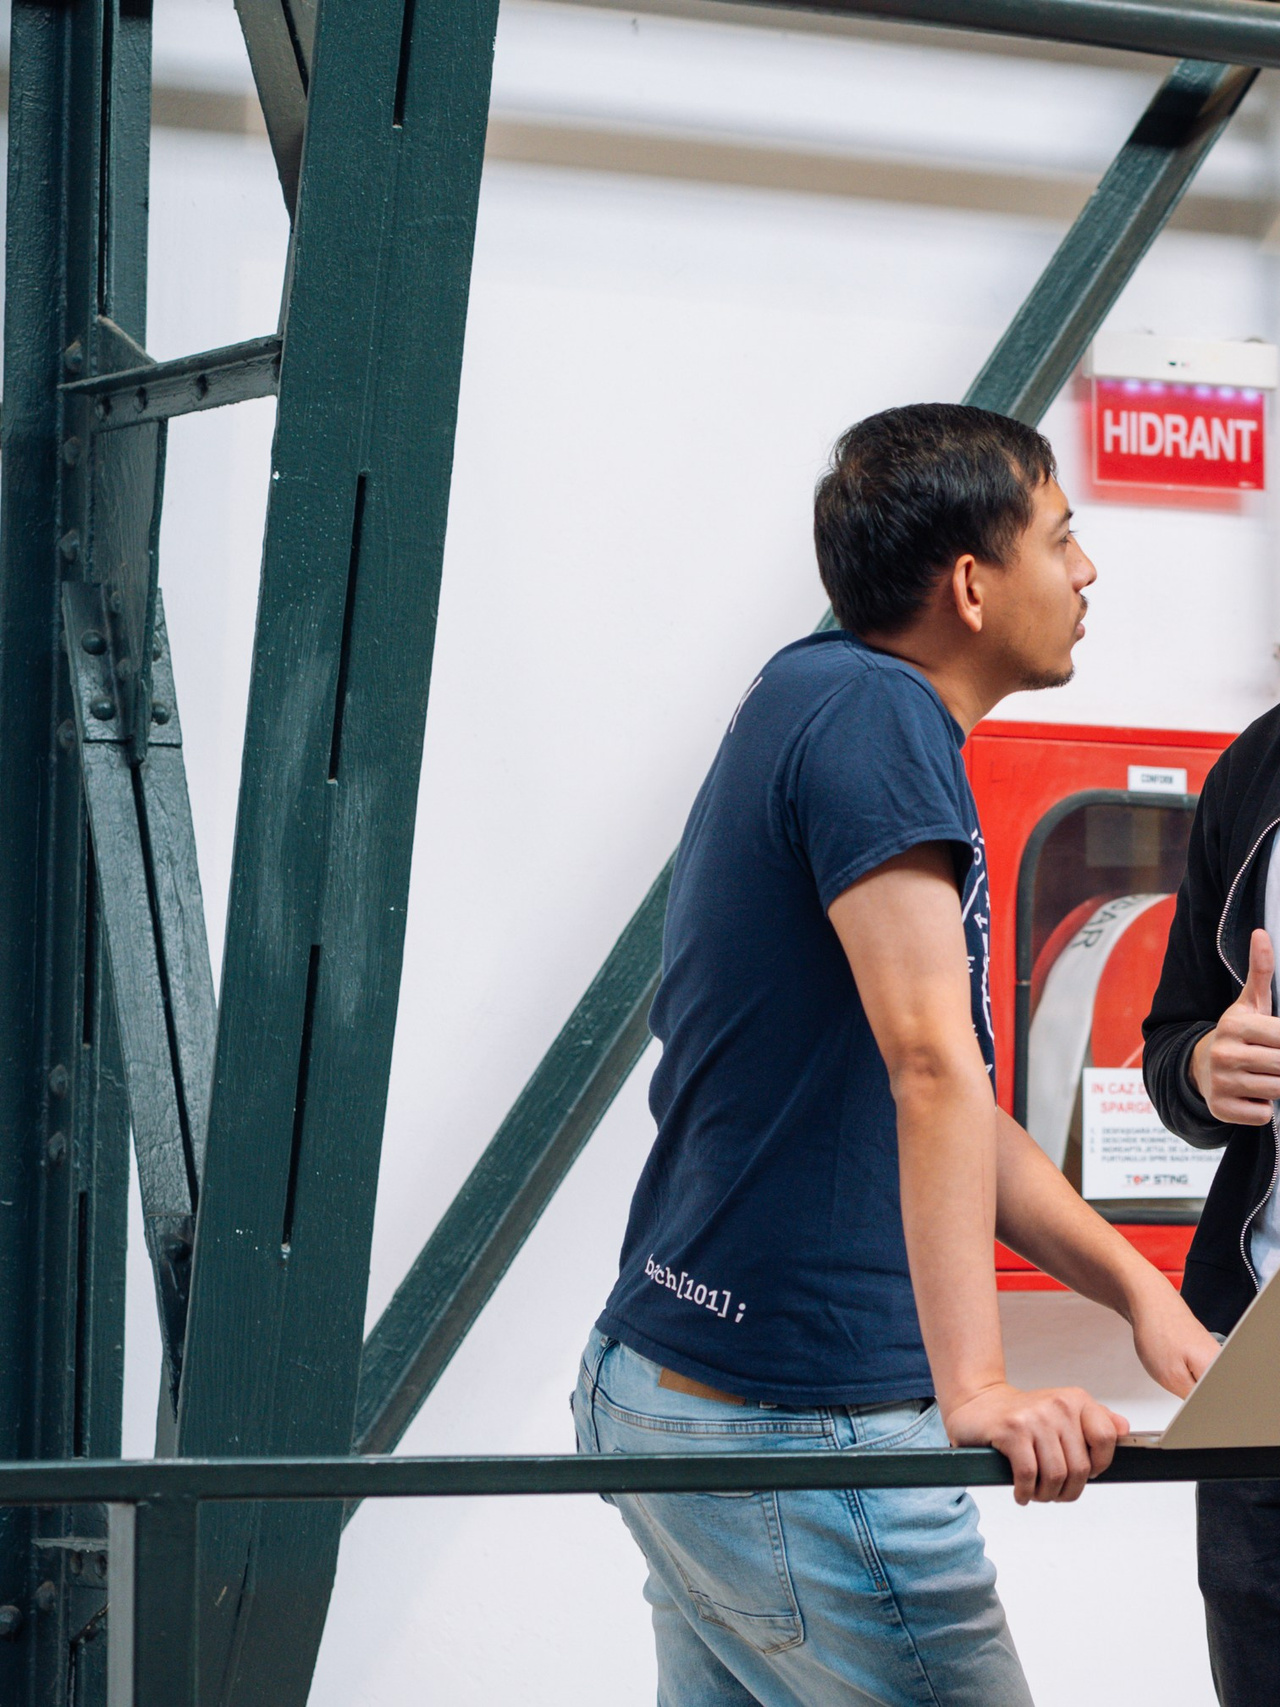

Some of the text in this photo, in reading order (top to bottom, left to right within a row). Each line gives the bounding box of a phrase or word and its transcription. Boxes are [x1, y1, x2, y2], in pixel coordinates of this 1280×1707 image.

[1103, 409, 1258, 463] HIDRANT
[1091, 1082, 1104, 1094] IN
[1108, 1082, 1135, 1095] CAZ
[1153, 1174, 1189, 1185] STING
